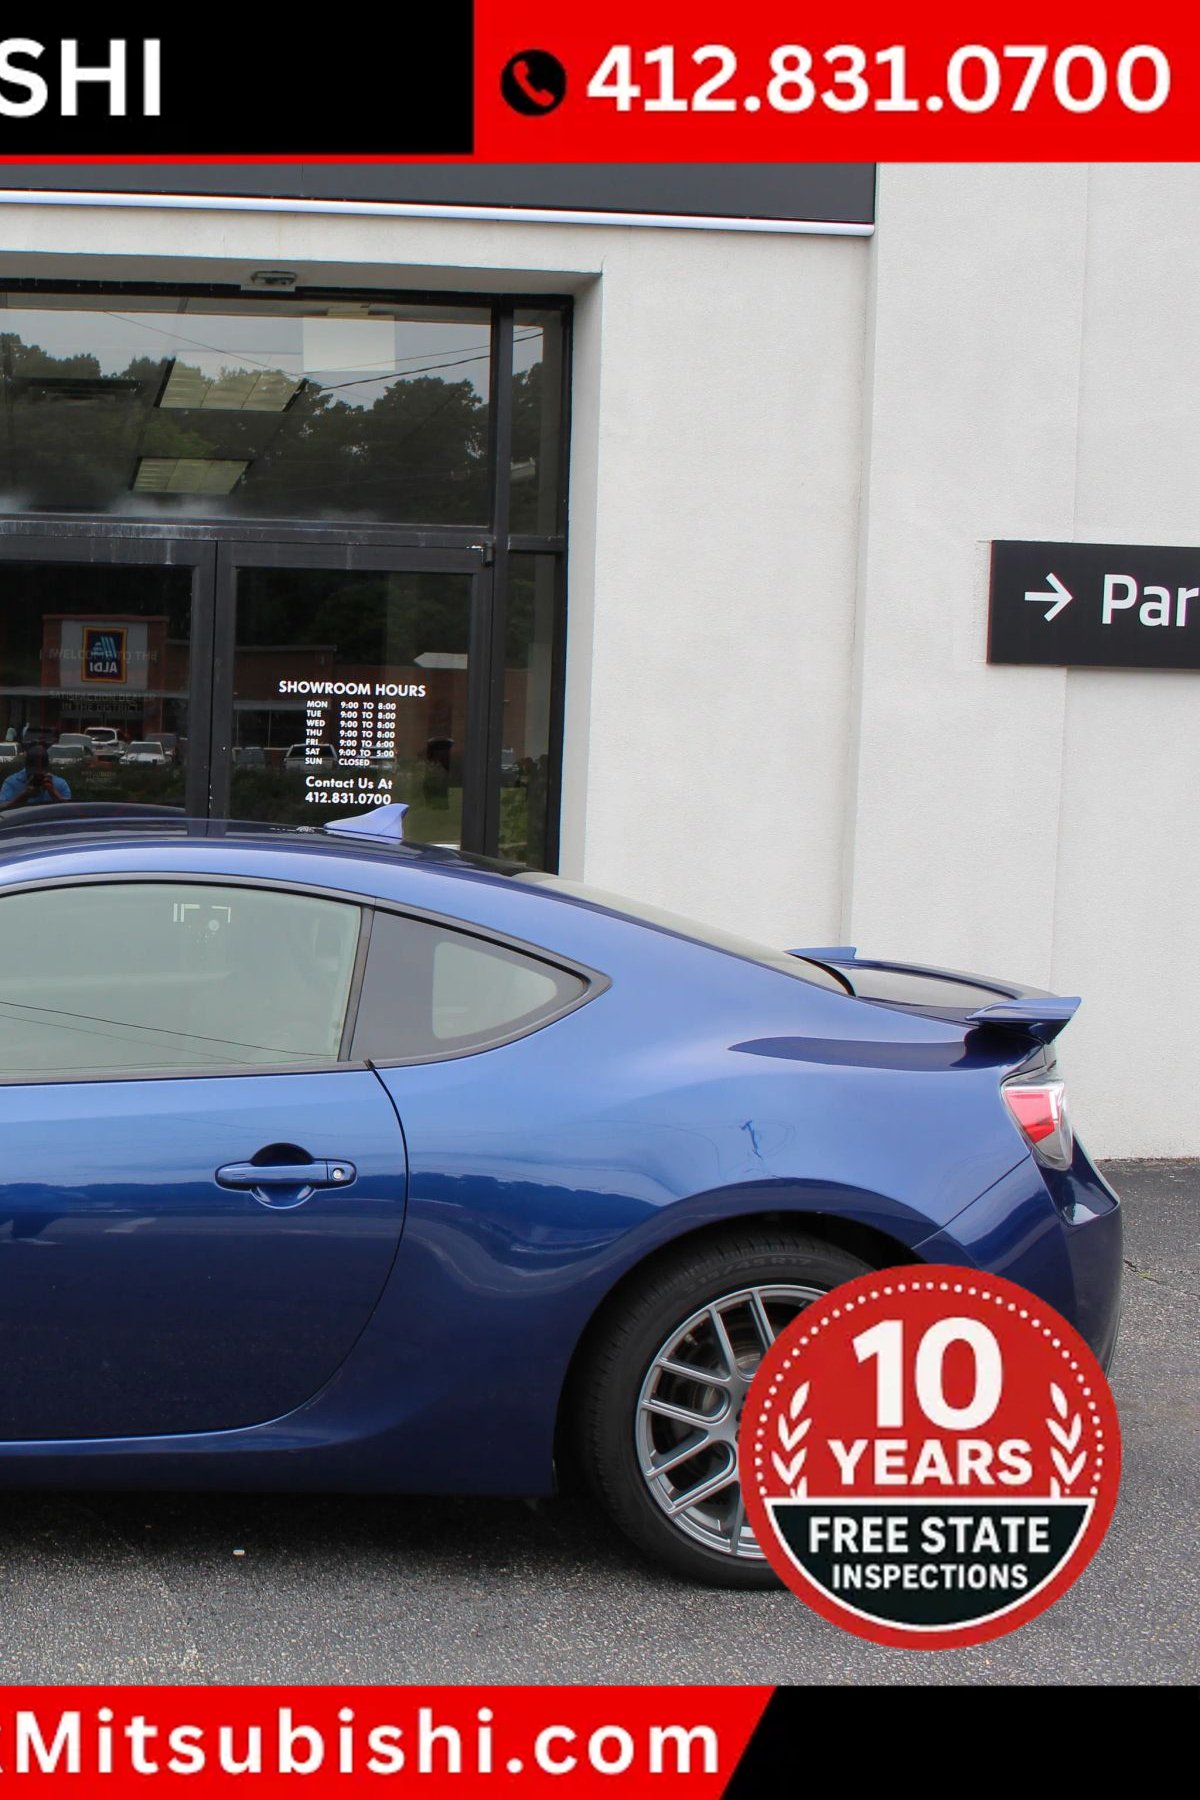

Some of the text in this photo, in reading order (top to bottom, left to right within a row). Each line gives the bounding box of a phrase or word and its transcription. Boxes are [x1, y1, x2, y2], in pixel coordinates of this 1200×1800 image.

[278, 680, 426, 698] SHOWROOM HOURS
[306, 700, 328, 708] MON
[340, 701, 359, 709] 9:00
[378, 712, 396, 720] 8:00
[306, 719, 326, 727] WED
[340, 720, 358, 728] 9:00
[377, 731, 396, 739] 8:00
[339, 739, 357, 747] 9:00
[361, 740, 373, 748] TO
[376, 741, 395, 749] 6:00
[305, 757, 370, 766] SUN CLOSED
[305, 776, 393, 790] Contact Us At
[304, 791, 392, 805] 412.831.0700
